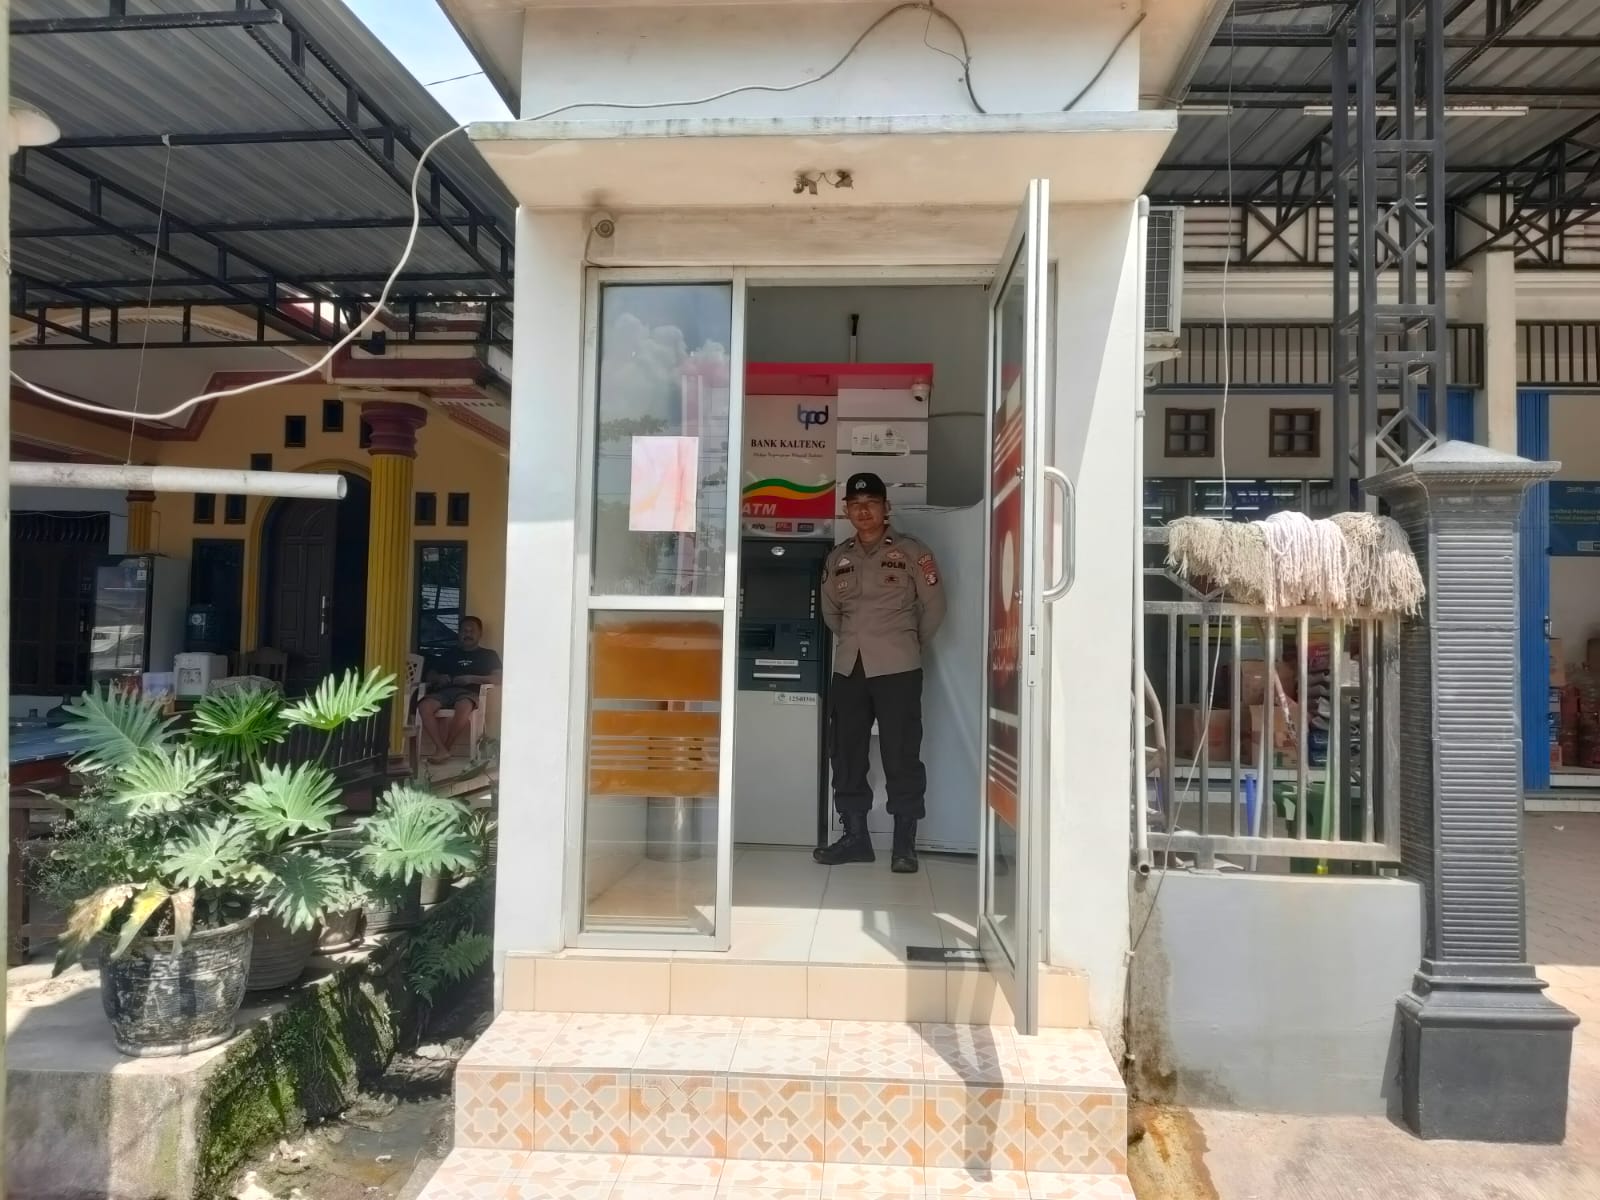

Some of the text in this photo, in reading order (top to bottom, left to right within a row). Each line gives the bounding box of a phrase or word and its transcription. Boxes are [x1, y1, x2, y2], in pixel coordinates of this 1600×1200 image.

[751, 439, 826, 449] BANK KALTENG
[742, 503, 777, 516] ATM
[881, 561, 906, 570] POLRI
